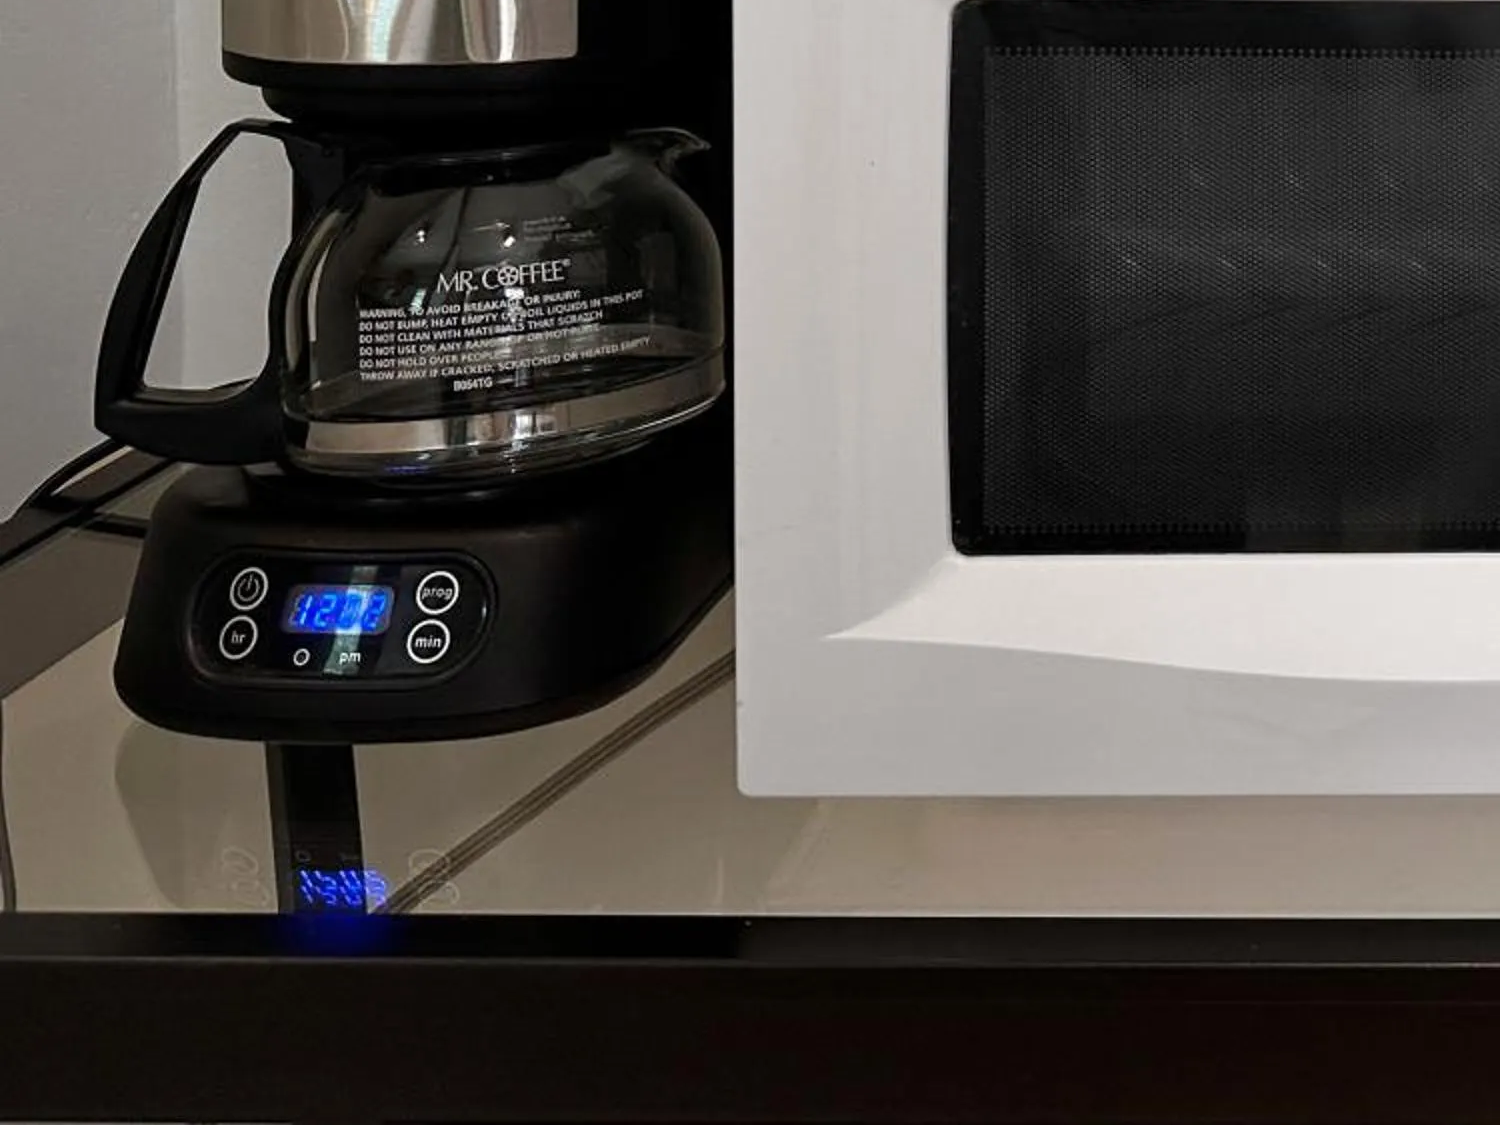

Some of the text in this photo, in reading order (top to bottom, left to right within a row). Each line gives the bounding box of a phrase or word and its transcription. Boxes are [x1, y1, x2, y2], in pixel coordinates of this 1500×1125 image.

[436, 271, 478, 294] MR.
[359, 322, 372, 331] DO
[374, 321, 395, 330] NOT
[432, 316, 458, 327] HEAT
[462, 313, 498, 325] EMPTY
[548, 301, 588, 315] LIQUIDS
[589, 299, 601, 308] IN
[602, 294, 624, 305] THIS
[626, 289, 644, 301] POT
[426, 304, 460, 315] AVOID
[464, 299, 520, 312] BREAKAGE
[524, 295, 540, 305] OR
[359, 310, 603, 343] DO NOT CLEAN WITH MATERIALS THAT SCRATCH
[359, 346, 372, 356] DO
[375, 346, 395, 355] NOT
[397, 344, 416, 354] USE
[419, 343, 436, 353] ON
[439, 341, 462, 351] ANY
[528, 332, 543, 342] OR
[546, 330, 568, 340] HOT
[359, 359, 373, 368] DO
[375, 358, 395, 368] NOT
[397, 357, 427, 367] HOLD
[429, 354, 458, 365] OVER
[360, 371, 395, 380] THROW
[397, 369, 427, 379] AWAY
[430, 368, 438, 377] IF
[498, 355, 561, 371] SCRATCHED
[563, 352, 579, 362] OR
[580, 344, 619, 358] HEATED
[421, 585, 453, 599] prog
[231, 631, 245, 644] hr
[415, 636, 442, 648] min
[339, 651, 361, 665] pm
